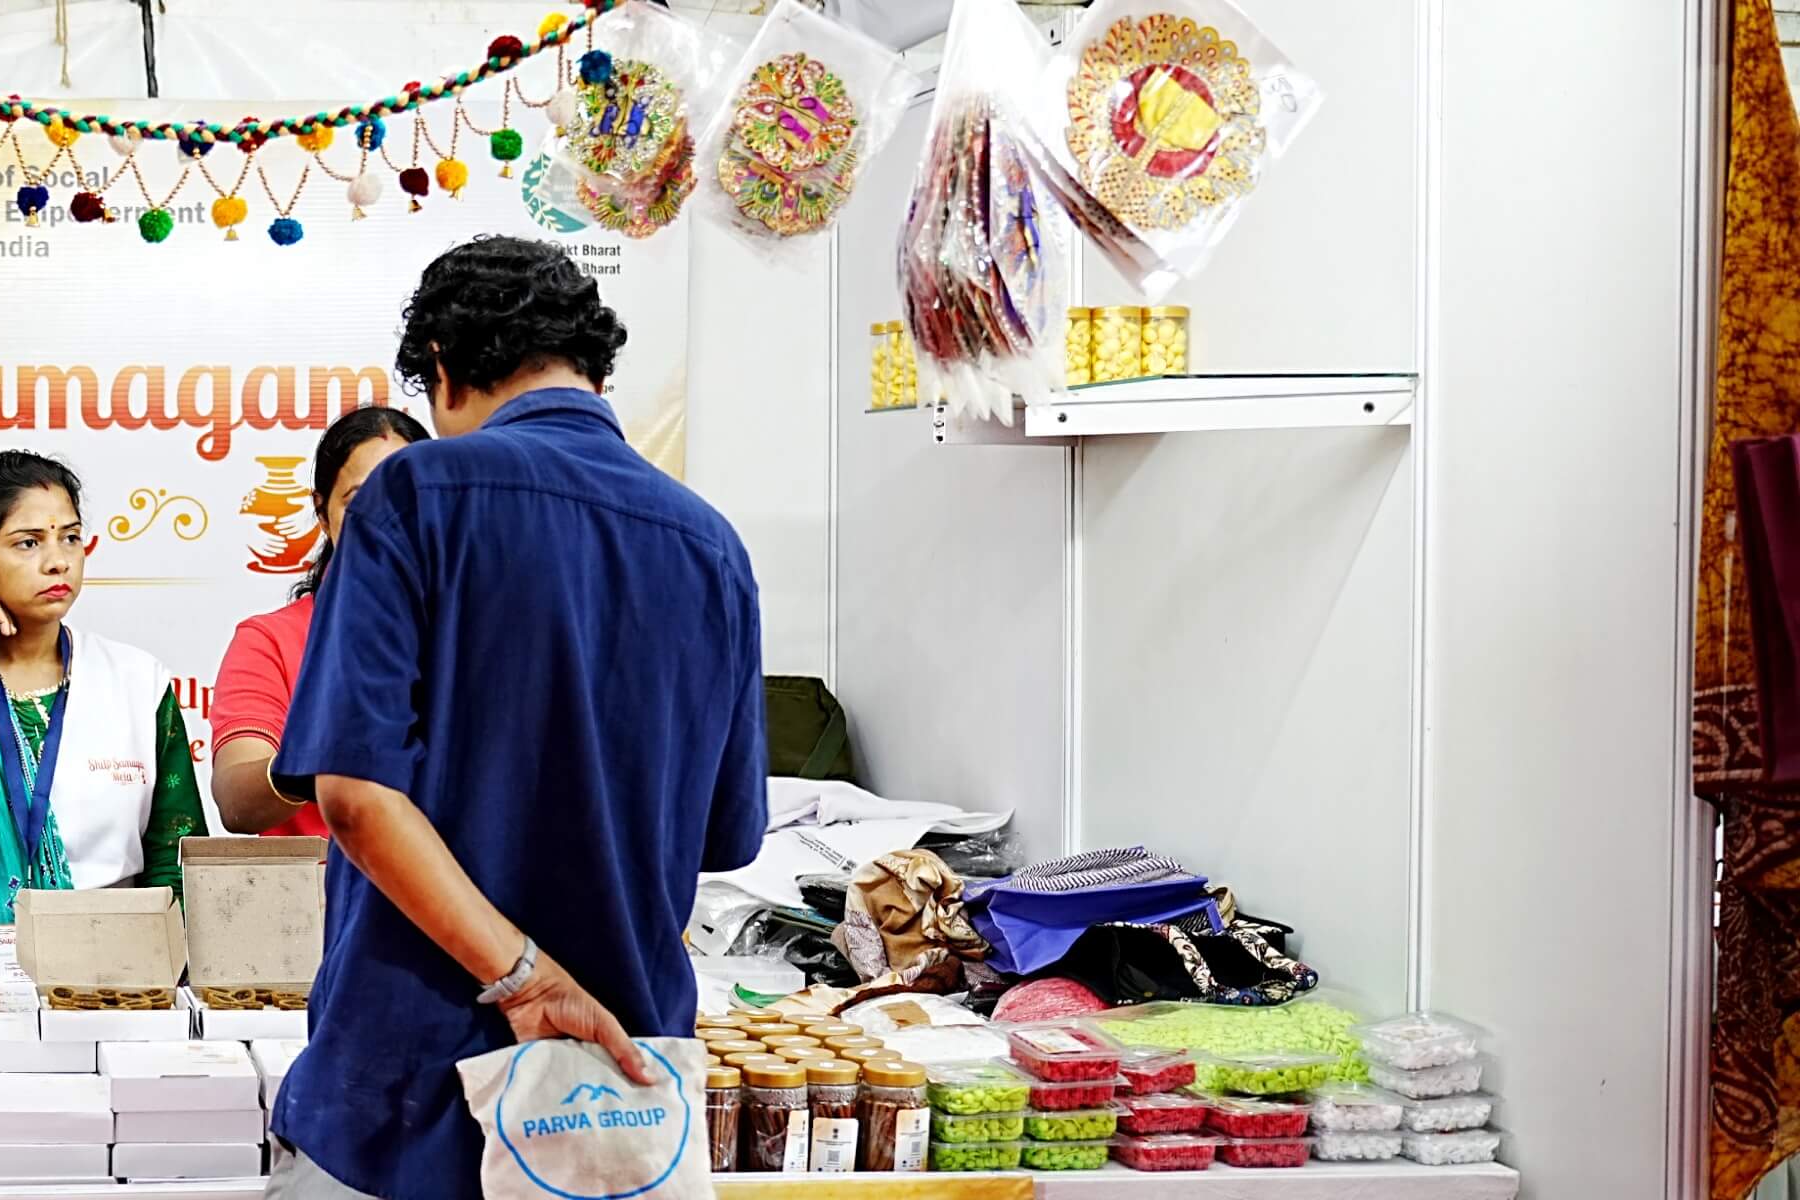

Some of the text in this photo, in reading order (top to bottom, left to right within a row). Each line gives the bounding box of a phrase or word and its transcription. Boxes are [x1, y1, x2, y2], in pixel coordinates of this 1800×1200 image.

[582, 243, 621, 257] Bharat
[582, 262, 621, 275] Bharat
[522, 1107, 667, 1139] PARVA GROUP
